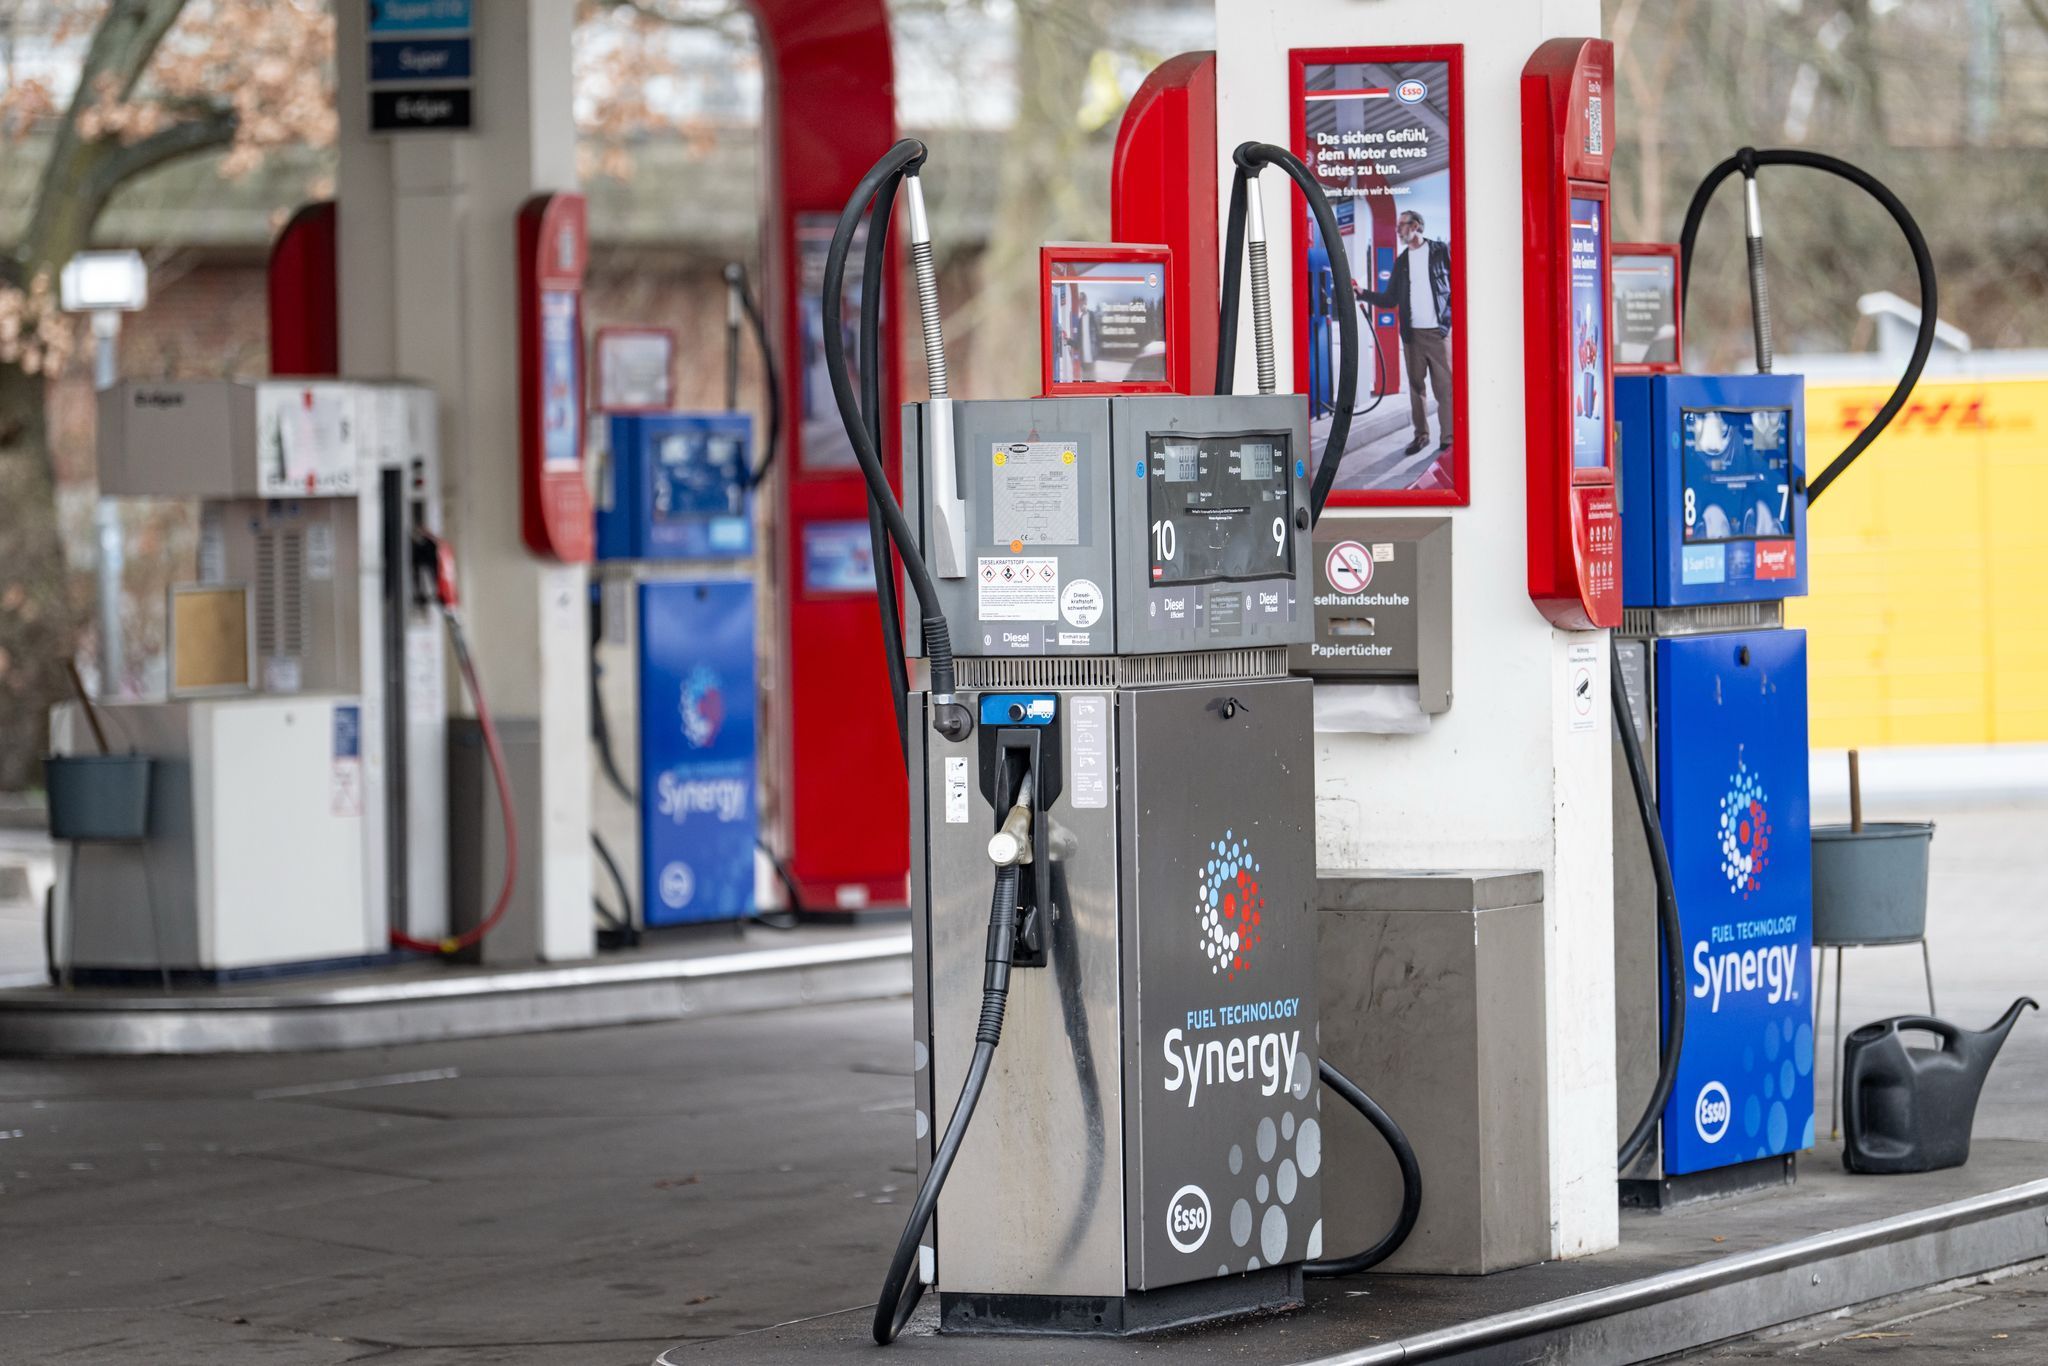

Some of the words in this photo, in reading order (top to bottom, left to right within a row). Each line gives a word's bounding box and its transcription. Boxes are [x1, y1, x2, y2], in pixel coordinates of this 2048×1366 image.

[1402, 87, 1422, 96] Esso
[1317, 133, 1339, 145] Das
[1342, 131, 1383, 143] sichere
[1386, 128, 1429, 143] Gefühl,
[1317, 148, 1345, 161] dem
[1348, 147, 1387, 160] Motor
[1390, 147, 1427, 158] etwas
[1318, 165, 1354, 176] Gutes
[1357, 166, 1372, 175] zu
[1376, 164, 1400, 175] tun.
[1344, 187, 1369, 196] fahren
[1370, 186, 1383, 195] wir
[1384, 186, 1411, 195] besser.
[1684, 488, 1697, 526] 8
[1777, 484, 1789, 521] 7
[1152, 520, 1176, 561] 10
[1272, 516, 1286, 557] 9
[1164, 598, 1184, 611] Diesel
[1259, 592, 1278, 605] Diesel
[1313, 593, 1409, 606] selhandschuhe
[1003, 632, 1030, 642] Diesel
[1311, 644, 1393, 658] Papiertücher
[658, 770, 747, 826] Synergy
[1712, 925, 1735, 943] FUEL
[1737, 916, 1797, 940] TECHNOLOGY
[1693, 940, 1797, 1013] Synergy
[1187, 1008, 1217, 1031] FUEL
[1219, 998, 1300, 1027] TECHNOLOGY
[1163, 1027, 1300, 1108] Synergy
[1701, 1098, 1727, 1125] Esso
[1173, 1205, 1205, 1233] Esso
